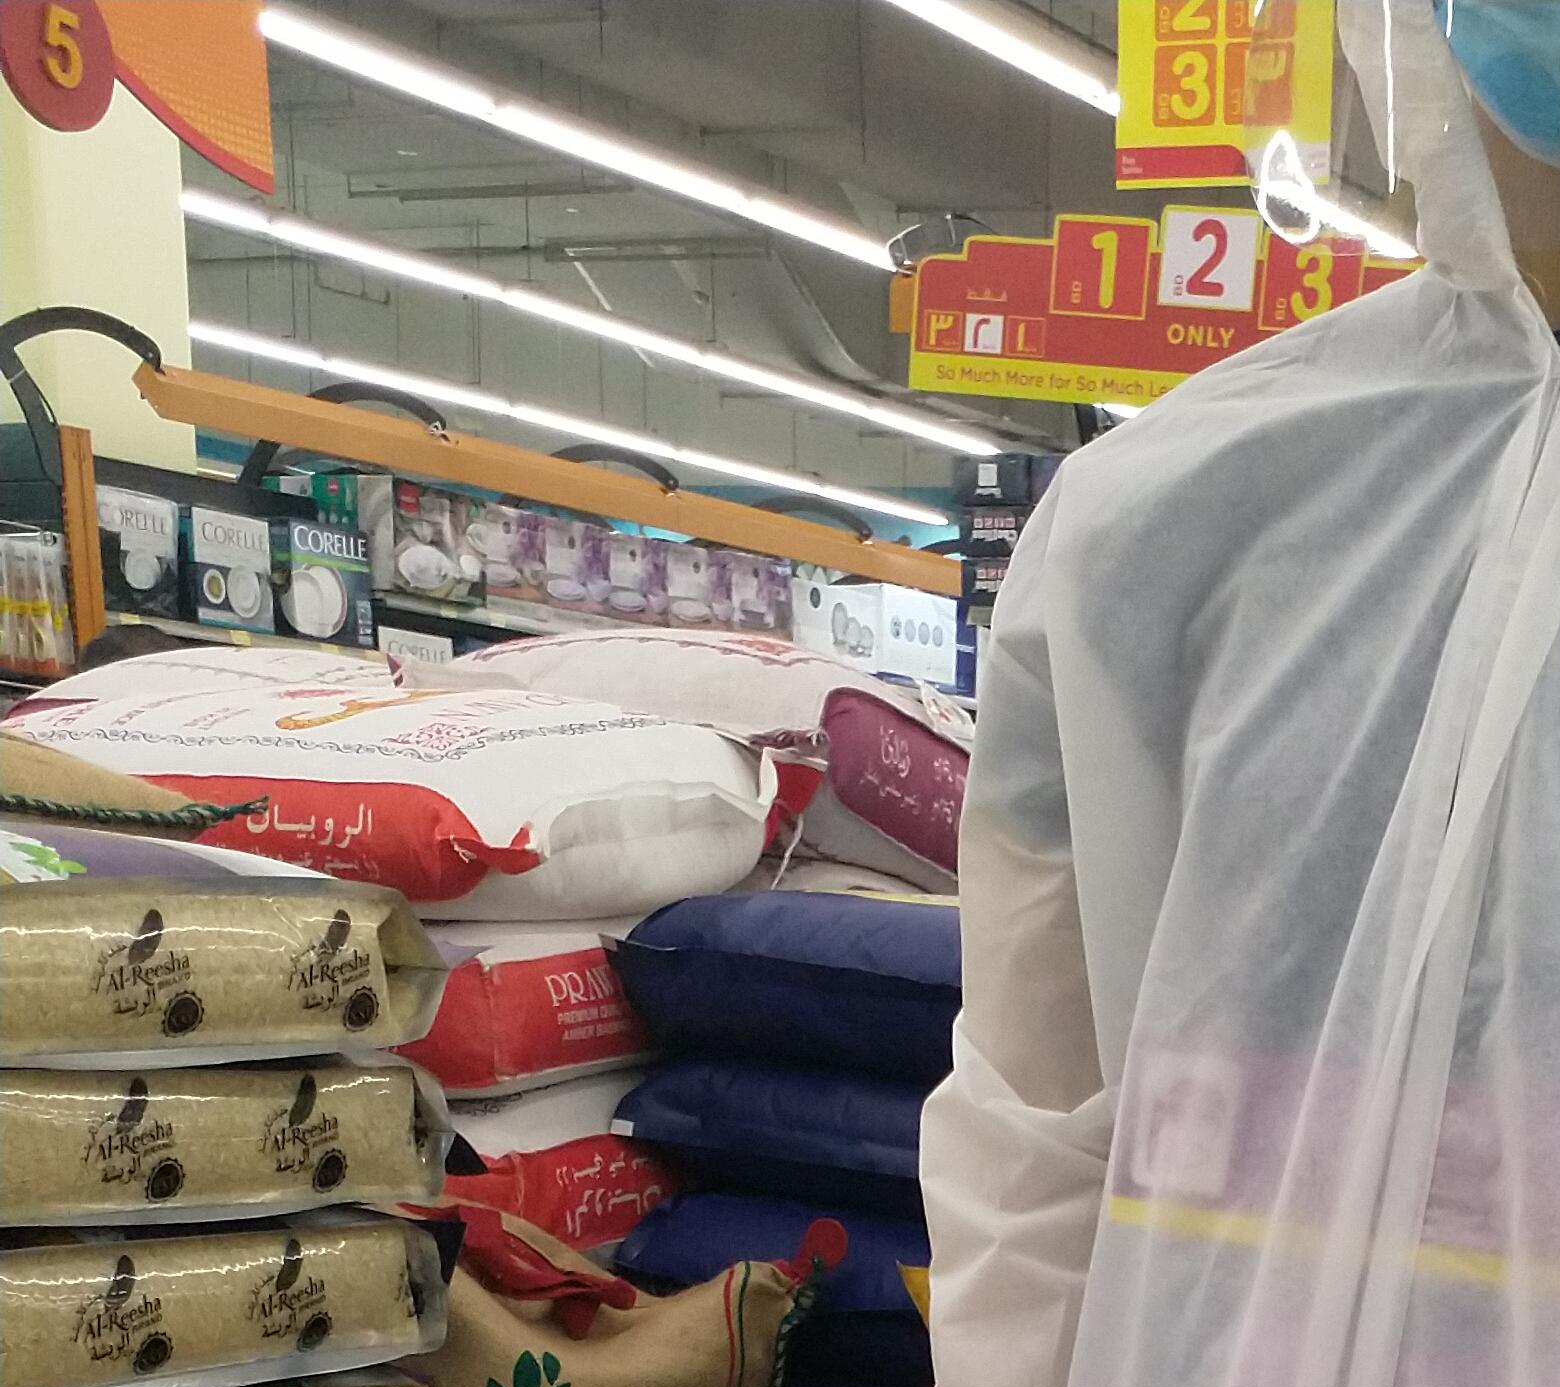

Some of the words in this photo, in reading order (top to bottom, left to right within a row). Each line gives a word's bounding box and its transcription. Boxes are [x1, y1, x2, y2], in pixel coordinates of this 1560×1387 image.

[41, 4, 83, 89] 5
[1170, 51, 1210, 120] 3
[1091, 231, 1120, 309] 1
[1186, 218, 1229, 297] 2
[1290, 244, 1333, 322] 3
[1167, 322, 1236, 350] ONLY
[936, 365, 955, 382] So
[960, 366, 1000, 386] Much
[1004, 369, 1045, 389] More
[1047, 373, 1071, 391] for
[1076, 375, 1097, 392] So
[1100, 376, 1145, 399] Much
[294, 525, 368, 561] CORELLE
[544, 964, 614, 1007] PRAW
